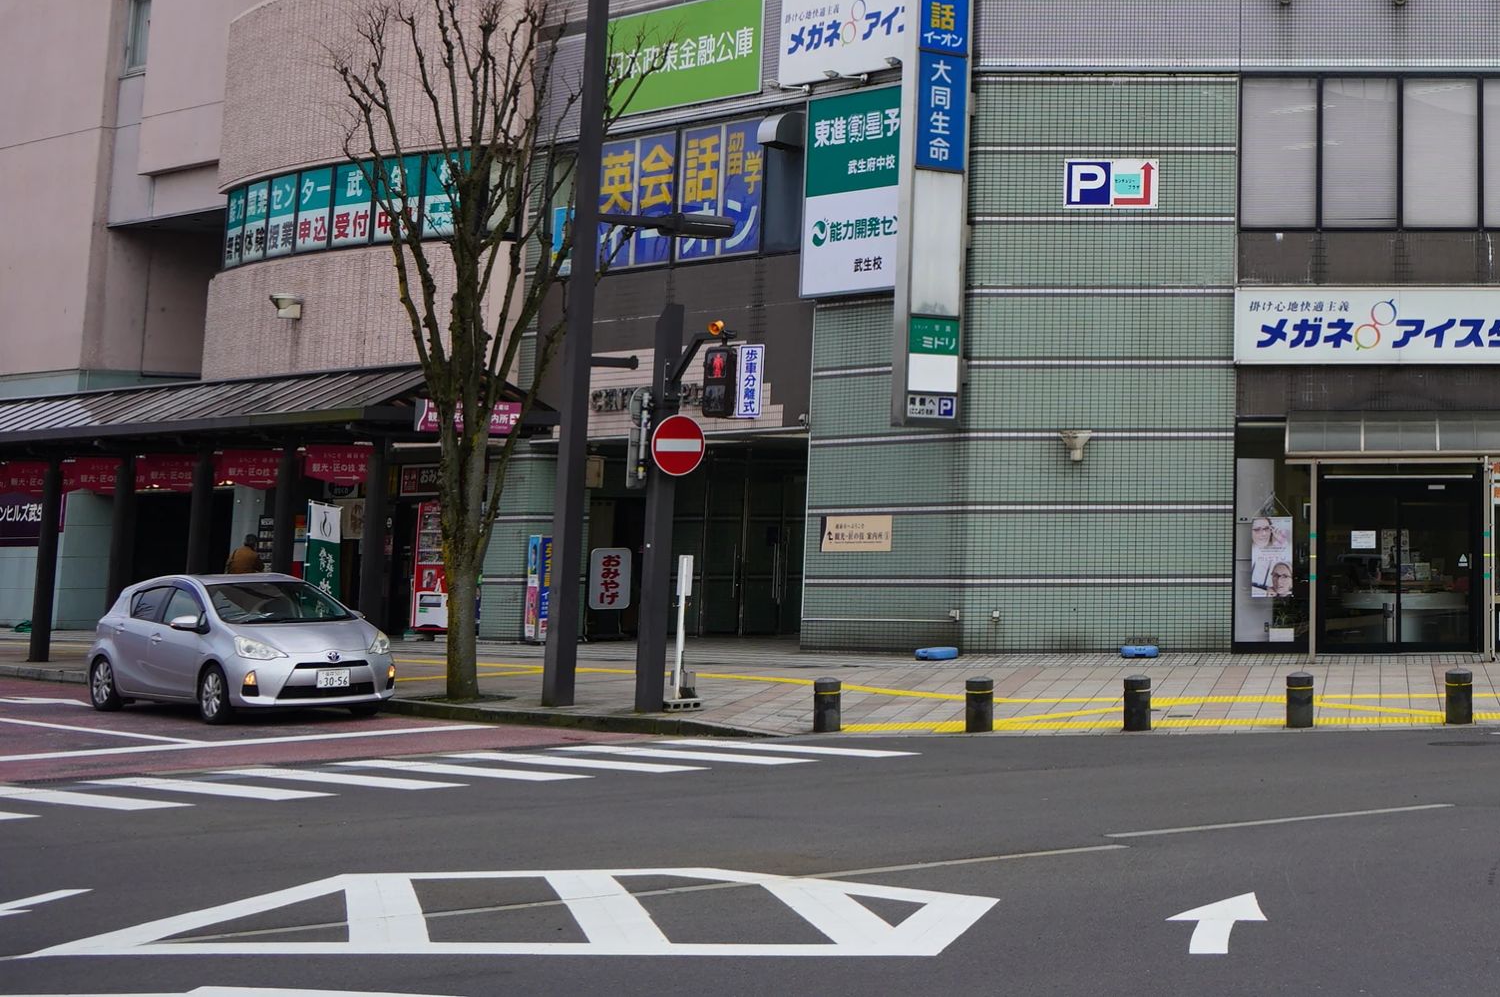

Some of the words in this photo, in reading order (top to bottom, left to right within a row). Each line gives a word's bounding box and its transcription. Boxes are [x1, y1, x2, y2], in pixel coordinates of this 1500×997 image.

[605, 26, 754, 83] 日本政策金融公庫
[923, 32, 963, 48] イーオン
[929, 60, 952, 162] 大同生命
[600, 134, 721, 215] 英会話
[847, 154, 896, 176] 武生府中校
[228, 178, 331, 224] 能力開発センター
[853, 255, 882, 273] 武生校
[1248, 300, 1351, 313] 掛け心地快適主義
[1256, 317, 1354, 349] メガネ
[743, 348, 760, 414] 歩車分離式
[599, 553, 621, 606] おみやげ
